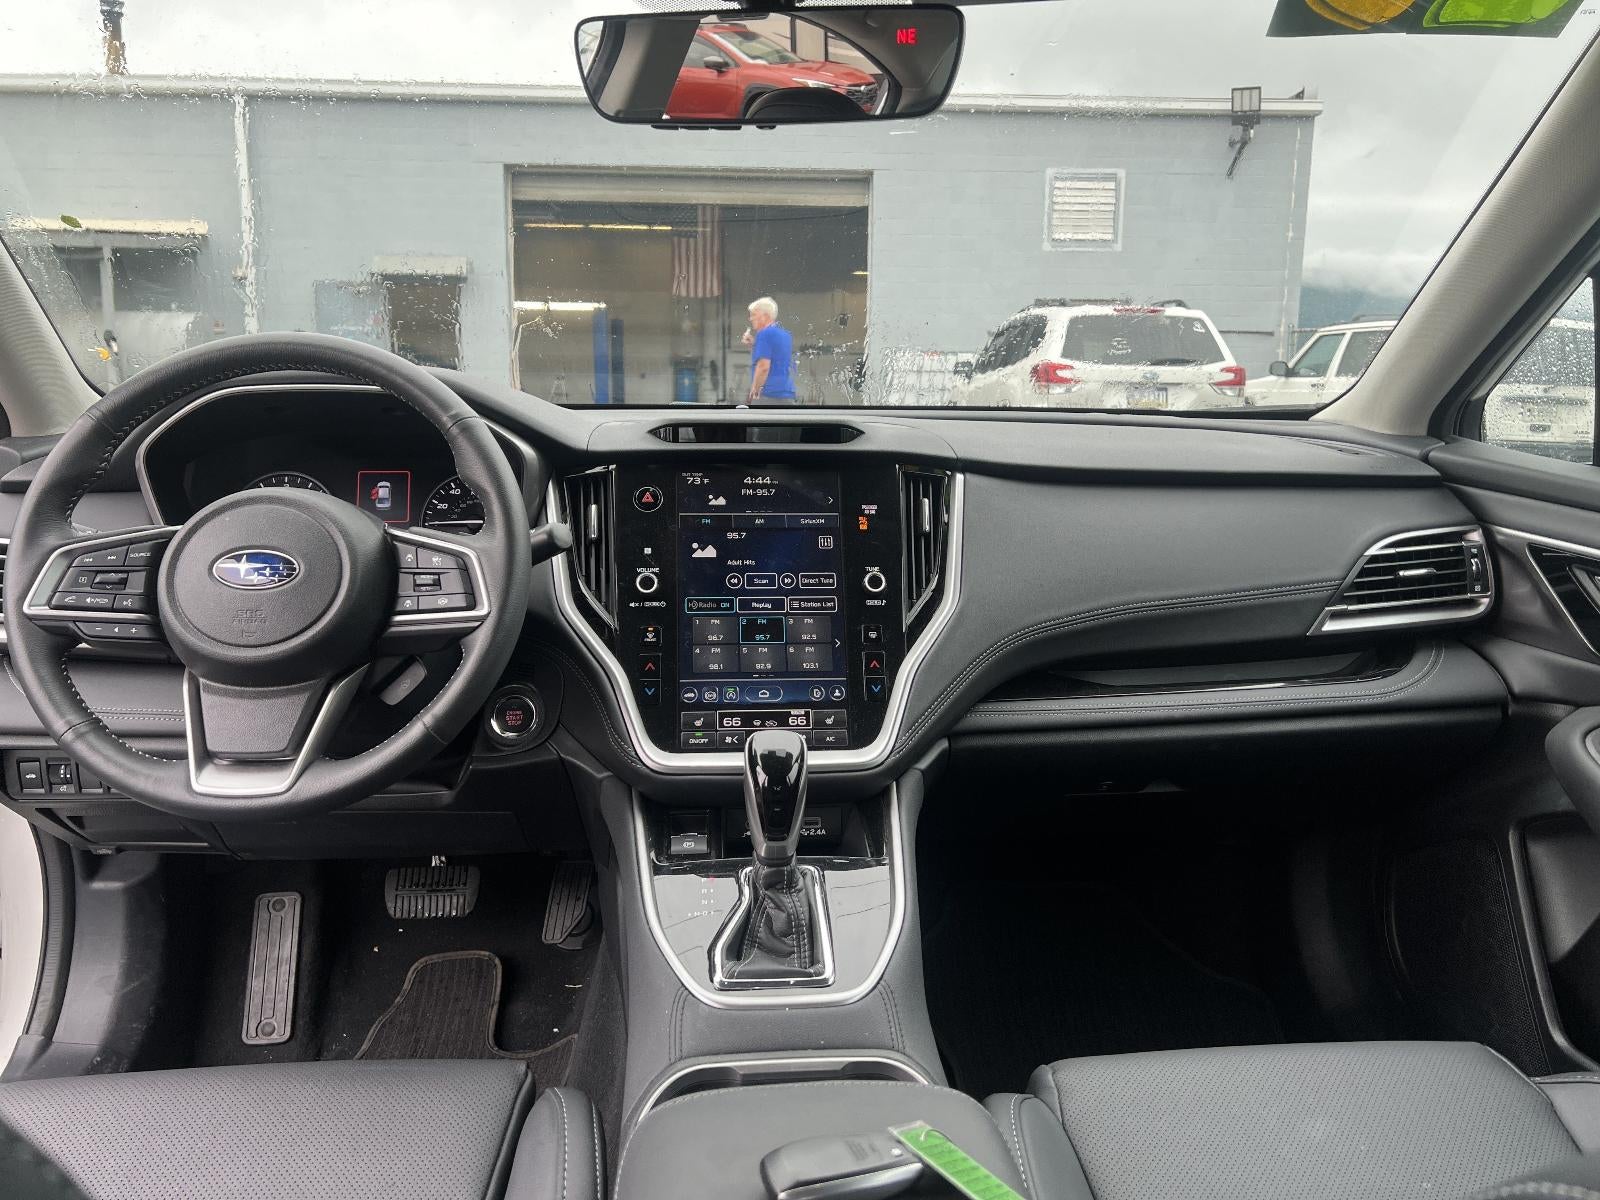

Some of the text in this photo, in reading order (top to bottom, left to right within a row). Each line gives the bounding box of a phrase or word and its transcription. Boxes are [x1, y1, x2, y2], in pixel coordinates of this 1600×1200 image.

[897, 28, 917, 44] NE
[687, 477, 700, 485] 73
[743, 476, 771, 485] 4:44
[742, 488, 776, 496] FM-95.7
[699, 600, 717, 608] Radio
[751, 601, 772, 609] Replay
[800, 600, 822, 608] Station
[723, 717, 741, 727] 66
[788, 716, 807, 726] 66
